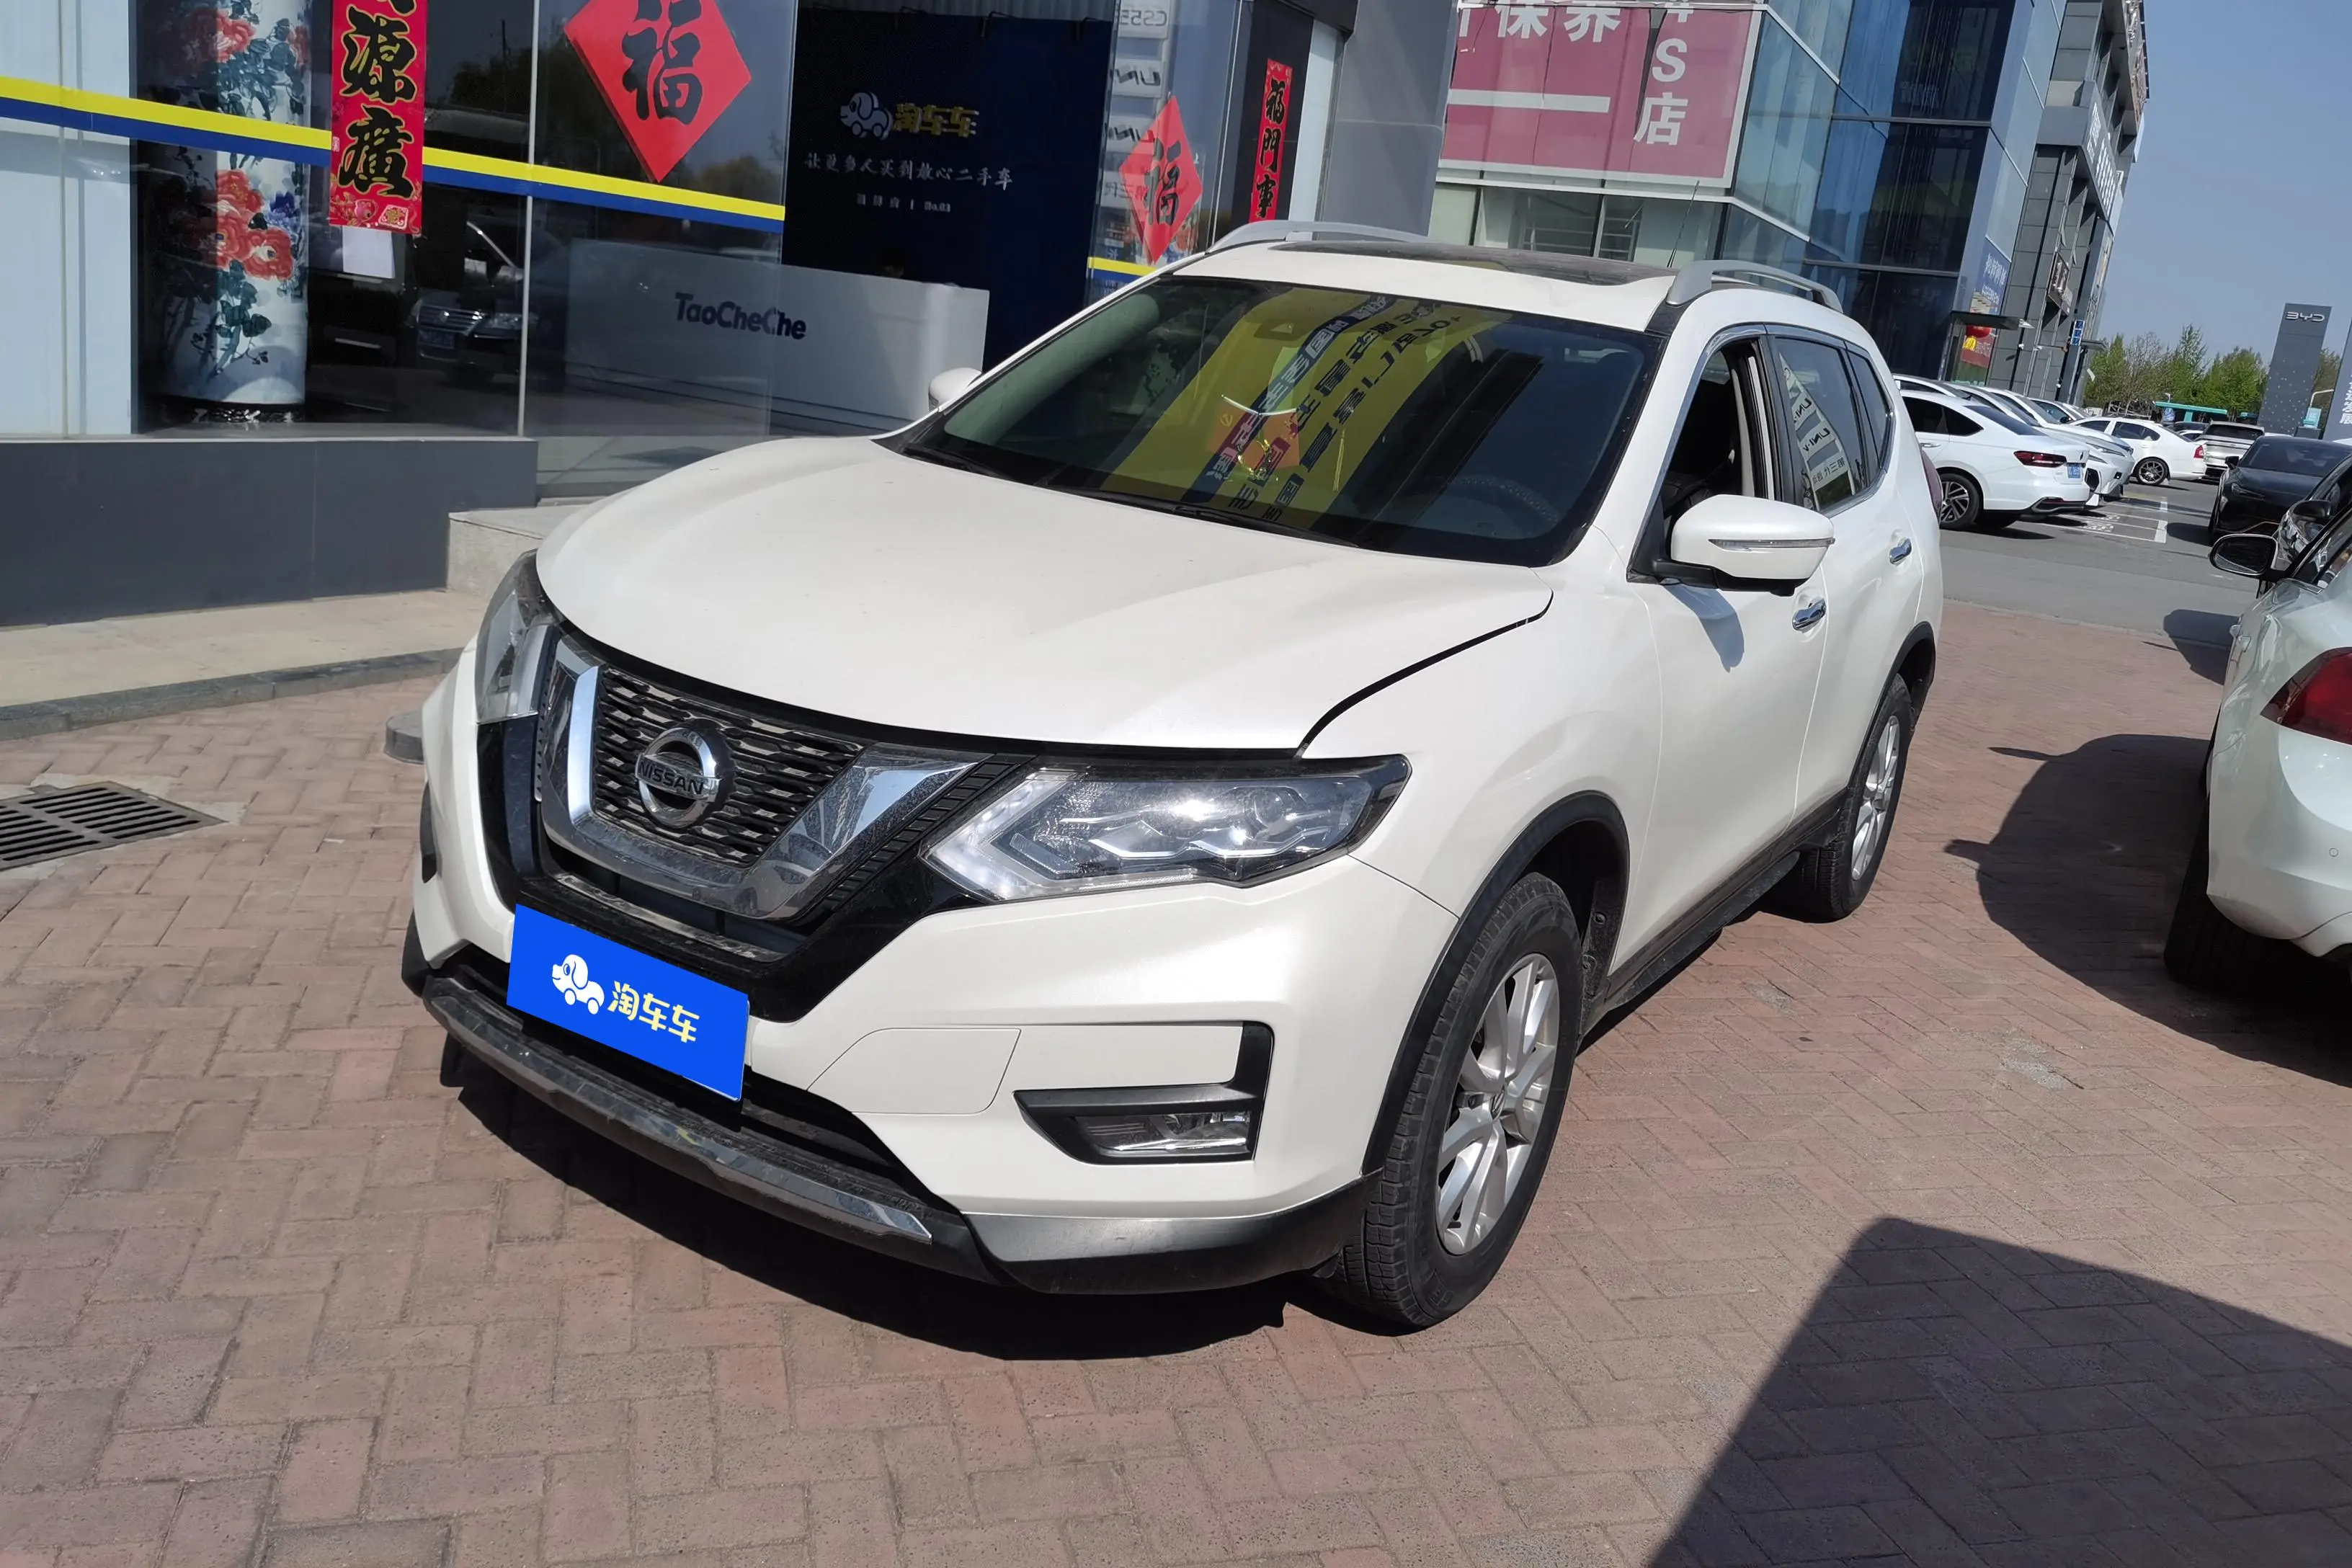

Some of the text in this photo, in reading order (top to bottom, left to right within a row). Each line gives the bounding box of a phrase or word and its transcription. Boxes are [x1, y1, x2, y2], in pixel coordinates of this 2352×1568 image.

[338, 0, 416, 199] 源廣
[674, 292, 806, 339] TaoCheChe
[2286, 311, 2325, 322] BYD
[638, 761, 704, 795] NISSAN
